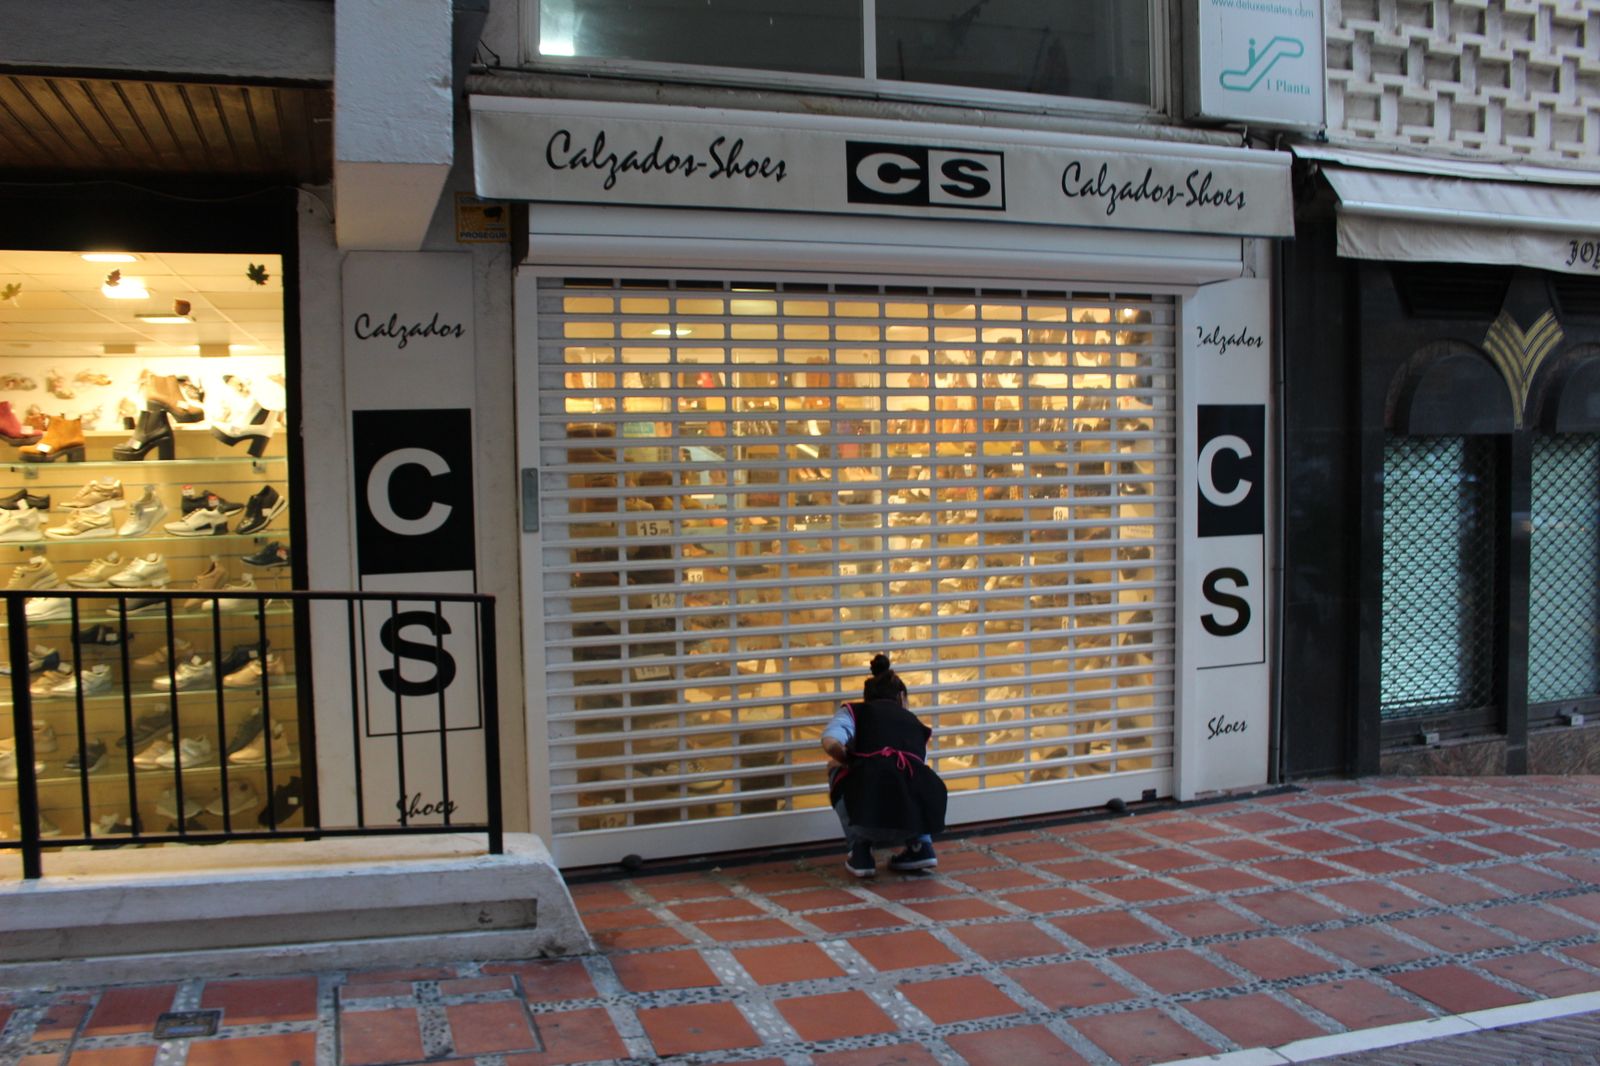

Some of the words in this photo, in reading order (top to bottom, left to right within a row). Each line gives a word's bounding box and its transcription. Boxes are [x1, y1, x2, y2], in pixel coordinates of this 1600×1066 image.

[1276, 80, 1311, 95] Planta
[546, 129, 787, 190] Calzados-Shoes
[1061, 161, 1247, 215] Calzados-Shoes
[354, 312, 466, 349] Calzados
[1207, 714, 1248, 740] Shoes
